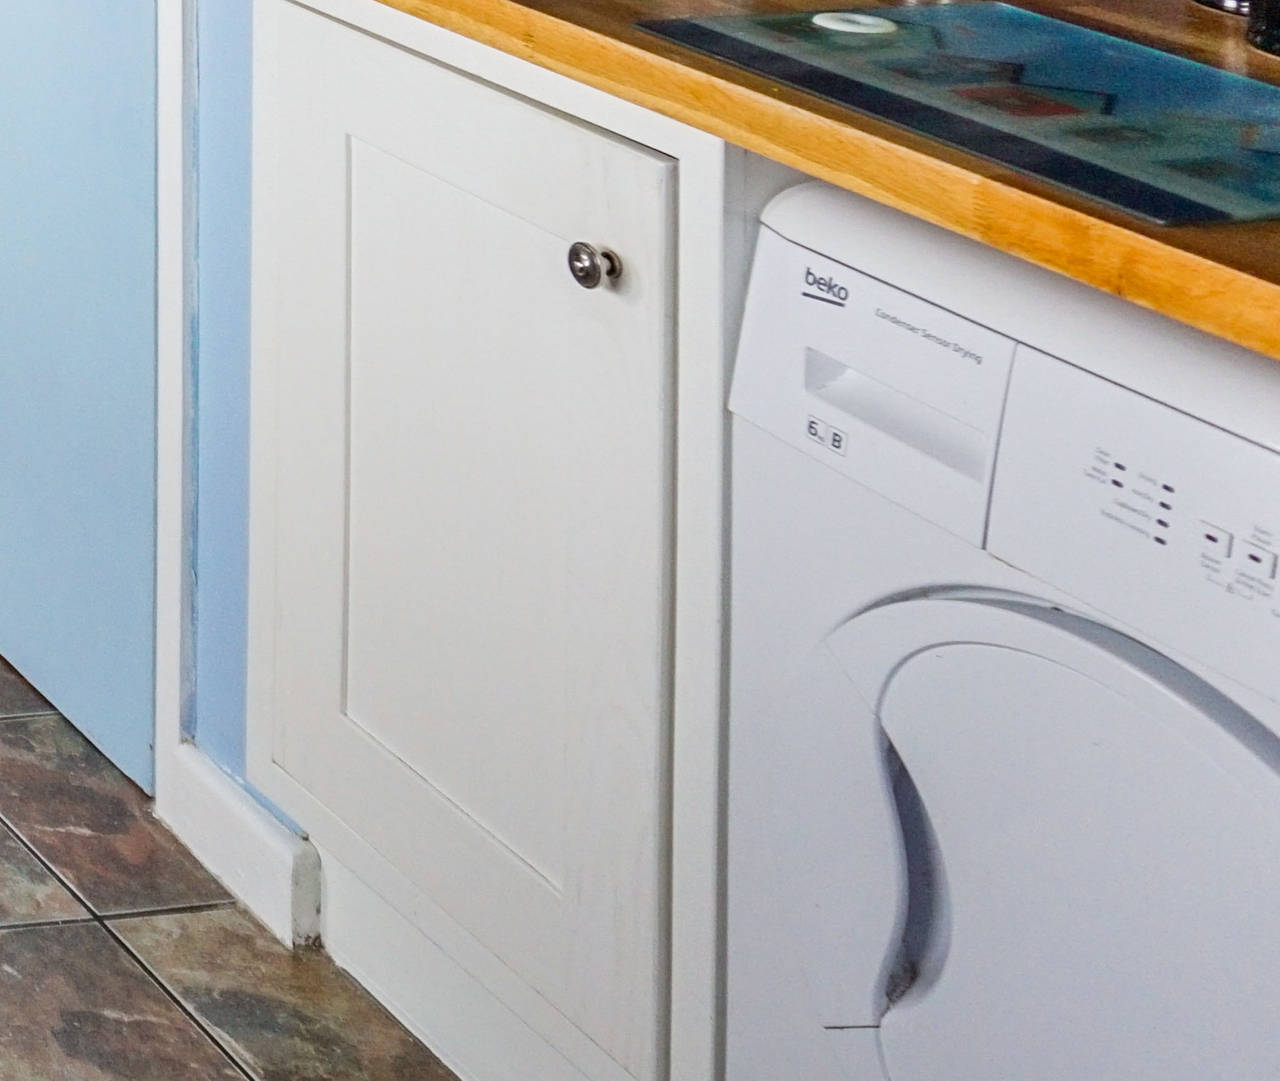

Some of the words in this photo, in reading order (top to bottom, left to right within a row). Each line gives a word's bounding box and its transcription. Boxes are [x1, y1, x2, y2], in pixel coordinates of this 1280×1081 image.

[805, 267, 849, 301] beko
[807, 420, 818, 437] 6
[831, 432, 842, 449] B
